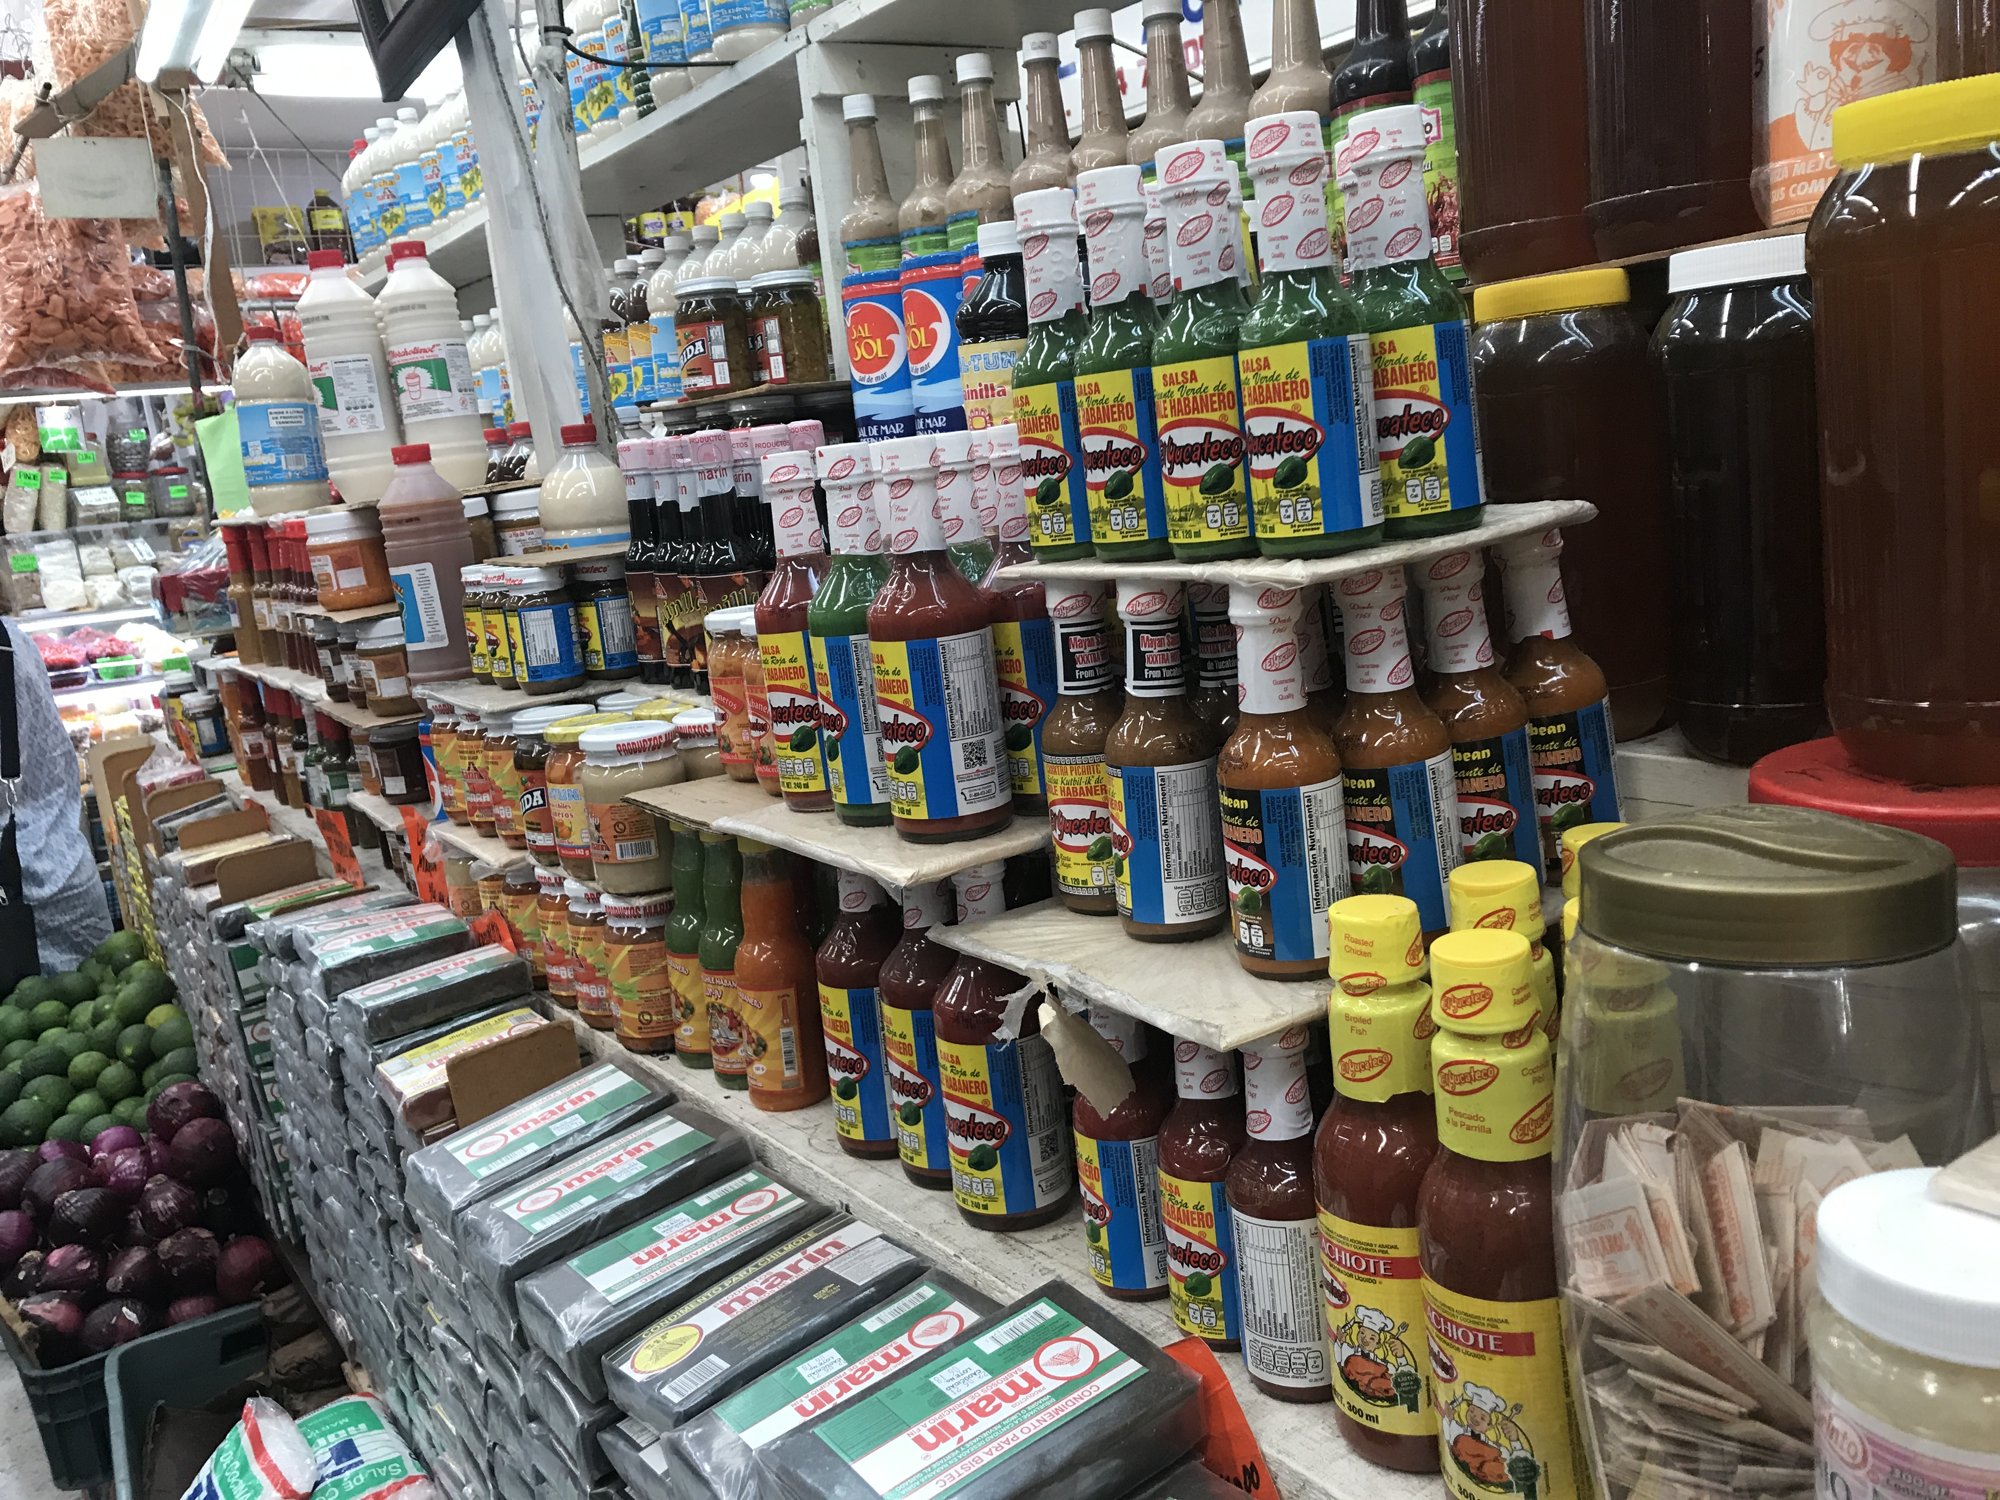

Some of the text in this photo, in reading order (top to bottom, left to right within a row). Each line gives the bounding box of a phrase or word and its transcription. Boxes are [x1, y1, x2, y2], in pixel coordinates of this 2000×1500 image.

[852, 323, 873, 339] SAL
[854, 338, 888, 361] SOL
[1375, 351, 1427, 369] Verde de
[1163, 370, 1198, 387] SALSA
[1253, 368, 1300, 385] Verde de
[1373, 360, 1436, 387] ABANERO
[1177, 380, 1227, 398] Verde de
[1248, 378, 1309, 406] HABANERO
[1085, 392, 1125, 407] Verde de
[1169, 391, 1235, 417] HABANERO
[1040, 405, 1052, 415] de
[869, 422, 905, 436] DE MAR
[924, 416, 947, 429] MAR
[1140, 634, 1166, 649] Mayan
[770, 654, 798, 667] Roja de
[939, 643, 950, 690] Nutrimental
[891, 667, 901, 677] de
[1076, 669, 1094, 679] From
[1144, 668, 1162, 679] From
[946, 690, 957, 739] Información
[1563, 736, 1577, 747] de
[1488, 763, 1501, 773] de
[1060, 784, 1107, 797] HABANER
[1372, 794, 1388, 805] de
[1160, 775, 1170, 825] Nutrimental
[1057, 810, 1112, 840] Yucatec
[1246, 815, 1259, 827] de
[1305, 794, 1317, 855] Nutrimental
[1162, 826, 1172, 880] Información
[1309, 856, 1322, 910] Información
[1344, 933, 1374, 948] Roasted
[1344, 944, 1372, 958] Chicken
[834, 1009, 843, 1018] de
[1345, 1013, 1372, 1025] Broiled
[1350, 1026, 1367, 1036] Fish
[950, 1065, 980, 1078] Roja de
[509, 1089, 597, 1137] marín
[1449, 1106, 1486, 1123] Pescado
[1451, 1119, 1459, 1129] la
[1460, 1121, 1492, 1134] Parrilla
[562, 1139, 655, 1190] marín
[1086, 1155, 1093, 1165] de
[1134, 1146, 1146, 1194] Nutrimental
[1167, 1193, 1205, 1211] Roja de
[1141, 1195, 1151, 1243] Información
[632, 1212, 732, 1266] marín
[680, 1242, 705, 1260] PARA
[1321, 1237, 1393, 1276] ACHIOTE
[639, 1257, 680, 1283] BISTEC
[718, 1238, 847, 1317] marín
[642, 1285, 723, 1338] CONDIMENTO
[724, 1266, 757, 1288] PARA
[756, 1229, 819, 1266] CHILMOLE
[1427, 1306, 1504, 1353] ACHIOTE
[794, 1340, 911, 1420] marín
[955, 1367, 972, 1379] LOTE
[979, 1367, 1024, 1394] SABROSOS
[967, 1390, 980, 1401] DE
[1010, 1387, 1046, 1409] PRODUCTOS
[912, 1371, 1042, 1451] marín
[928, 1397, 968, 1426] PRINCIPIO
[1347, 1401, 1380, 1425] 300 ml
[906, 1427, 921, 1438] FIN
[935, 1384, 1101, 1489] CONDIMENTO PARA BISTEC
[368, 1462, 402, 1478] SAL
